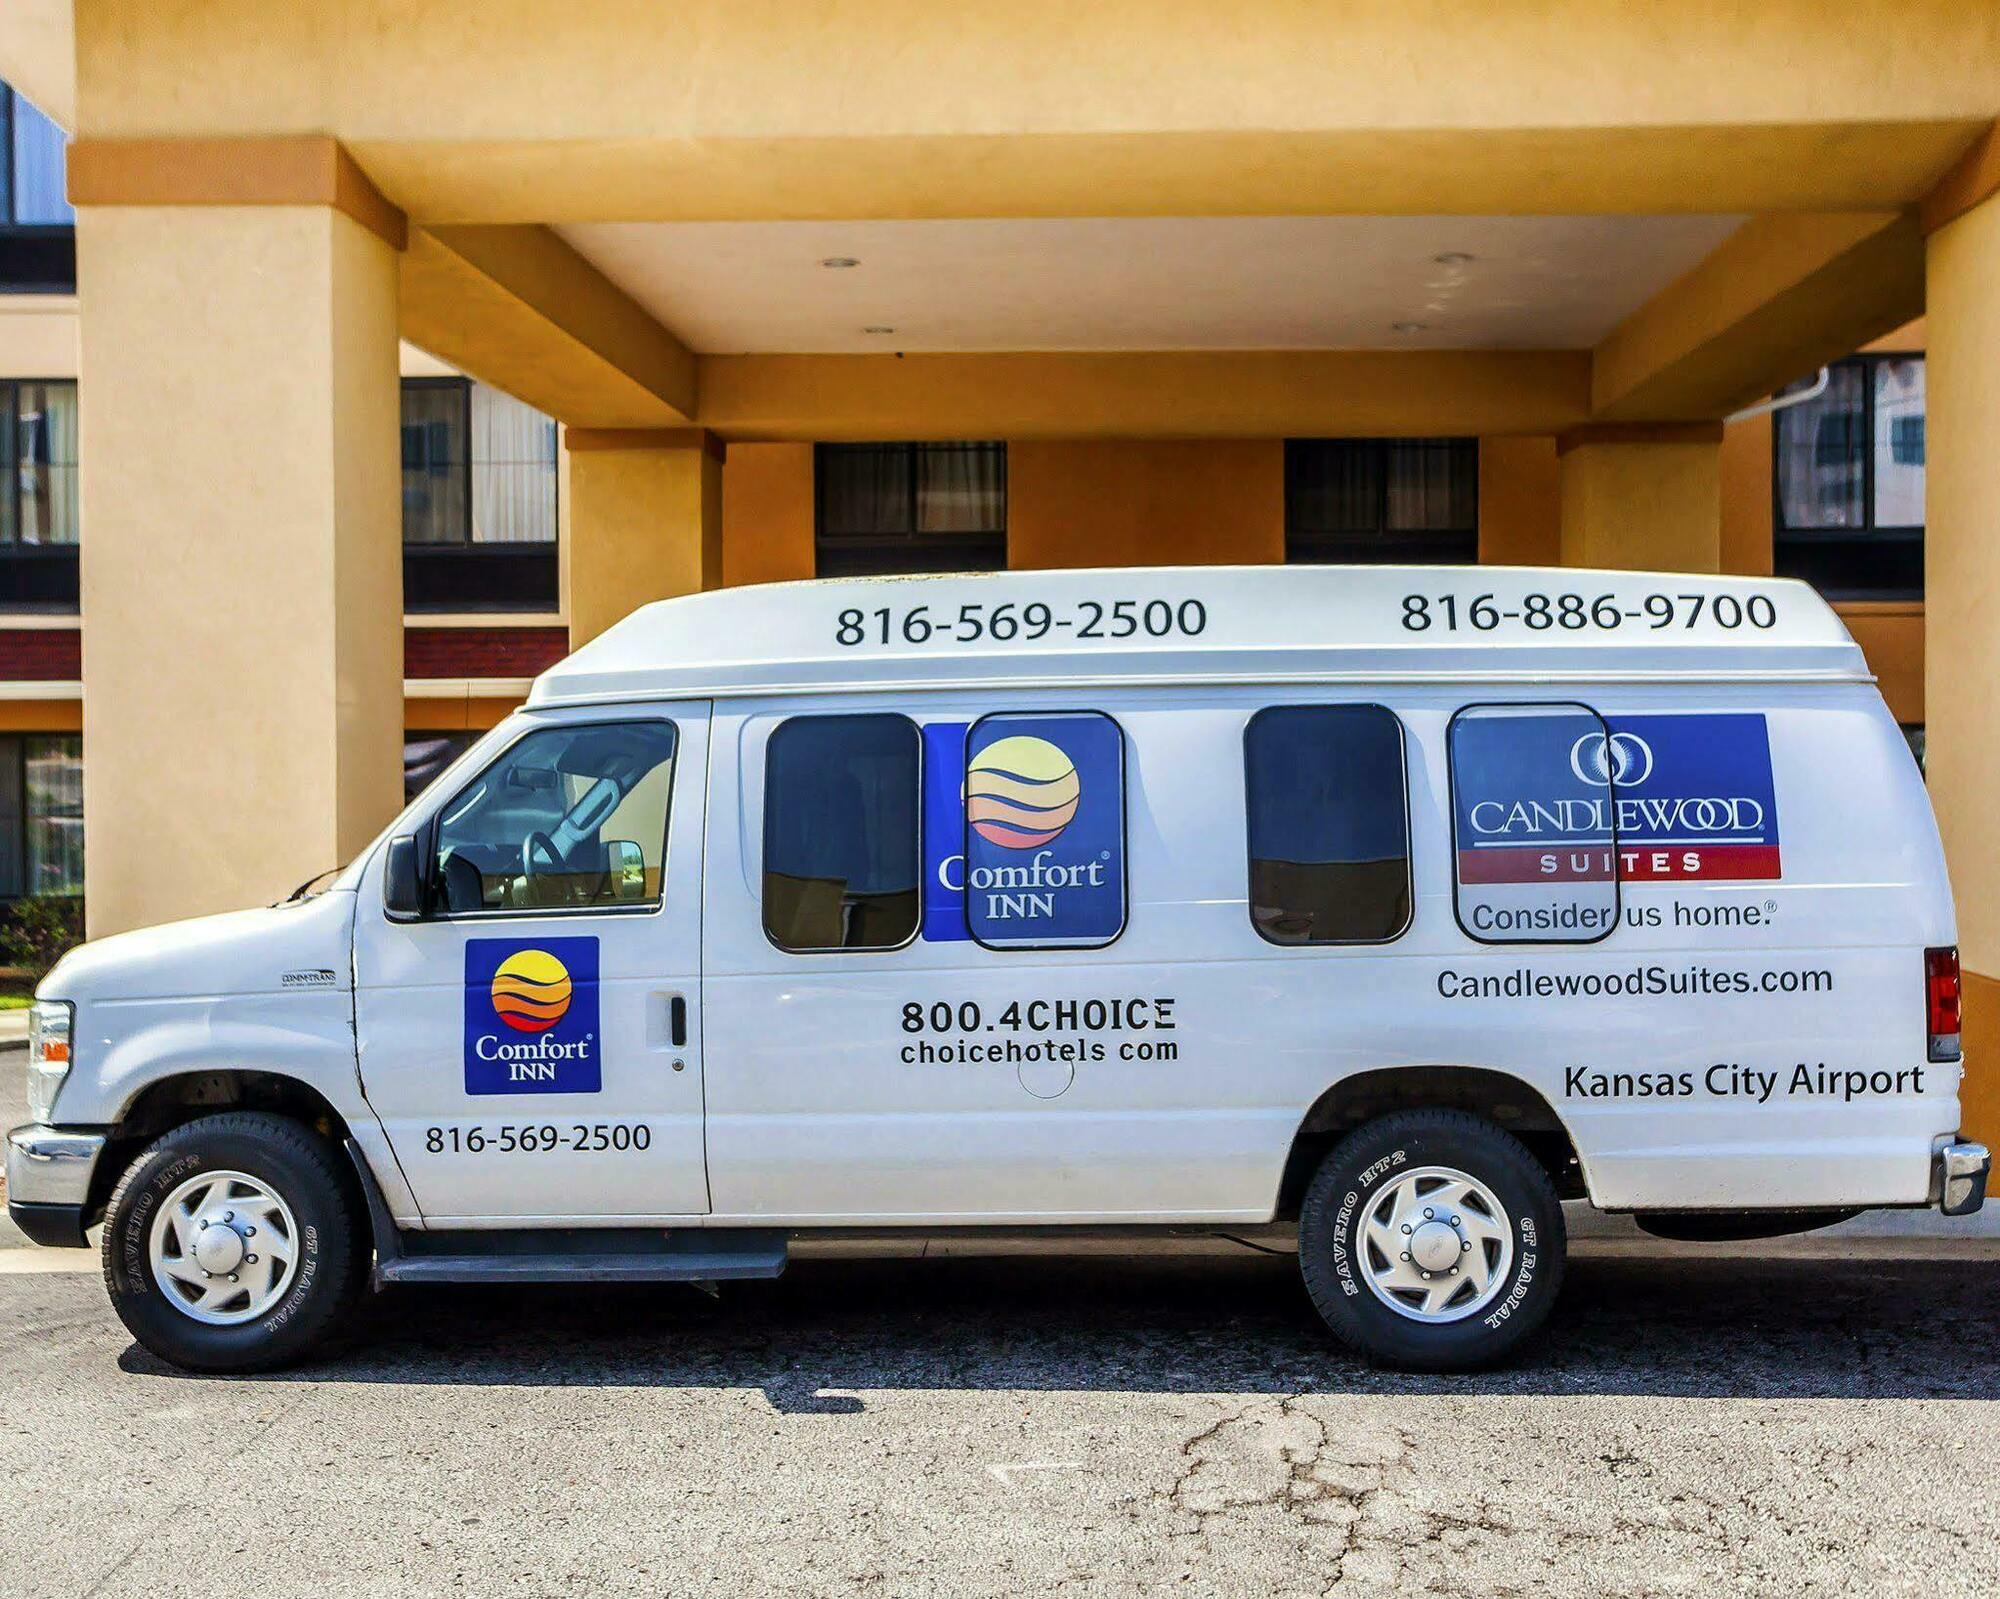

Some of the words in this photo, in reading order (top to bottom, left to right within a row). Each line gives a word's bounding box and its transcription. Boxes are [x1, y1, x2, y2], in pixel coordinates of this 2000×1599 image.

[836, 599, 1207, 645] 816-569-2500
[1401, 593, 1777, 632] 816-886-9700
[1470, 797, 1764, 834] CANDLEWOOD
[1540, 851, 1701, 874] SUITES
[986, 892, 1055, 920] INN
[1472, 901, 1611, 931] Consider
[1626, 905, 1662, 928] us
[1437, 966, 1832, 998] CandlewoodSuites.com
[901, 998, 1176, 1033] 800.4CHOICE
[900, 1038, 1106, 1063] choicehotels
[1118, 1041, 1178, 1061] com
[509, 1062, 556, 1081] INN
[1564, 1066, 1694, 1098] Kansas
[1704, 1063, 1778, 1104] City
[1788, 1063, 1925, 1102] Airport
[425, 1124, 652, 1154] 816-569-2500
[1332, 1190, 1360, 1297] SAVERO
[1358, 1150, 1407, 1188] HT2
[1520, 1216, 1537, 1247] GT
[1484, 1253, 1537, 1329] RADIAL
